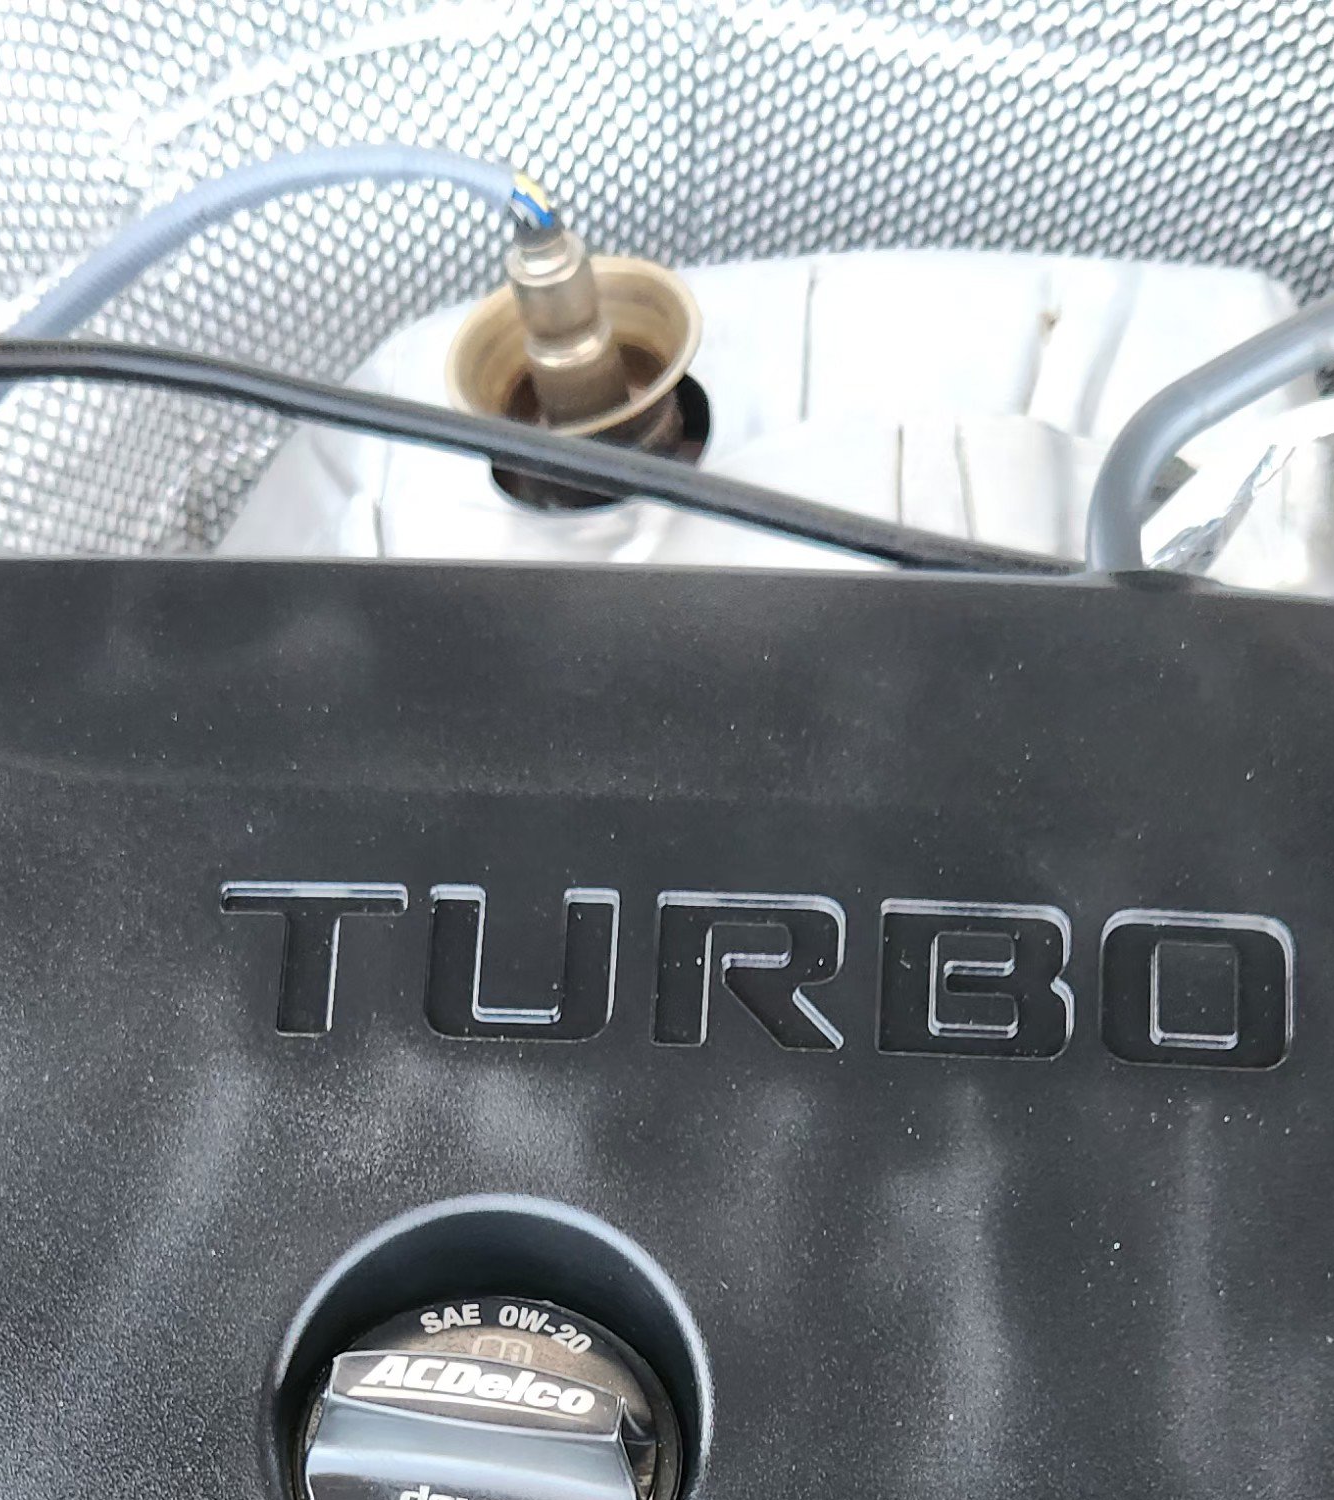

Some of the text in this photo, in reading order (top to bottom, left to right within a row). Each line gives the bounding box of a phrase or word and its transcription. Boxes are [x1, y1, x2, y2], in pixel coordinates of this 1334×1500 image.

[219, 879, 1295, 1071] TURBO
[420, 1303, 593, 1354] SAE 0W-20
[359, 1354, 596, 1415] ACDelco
